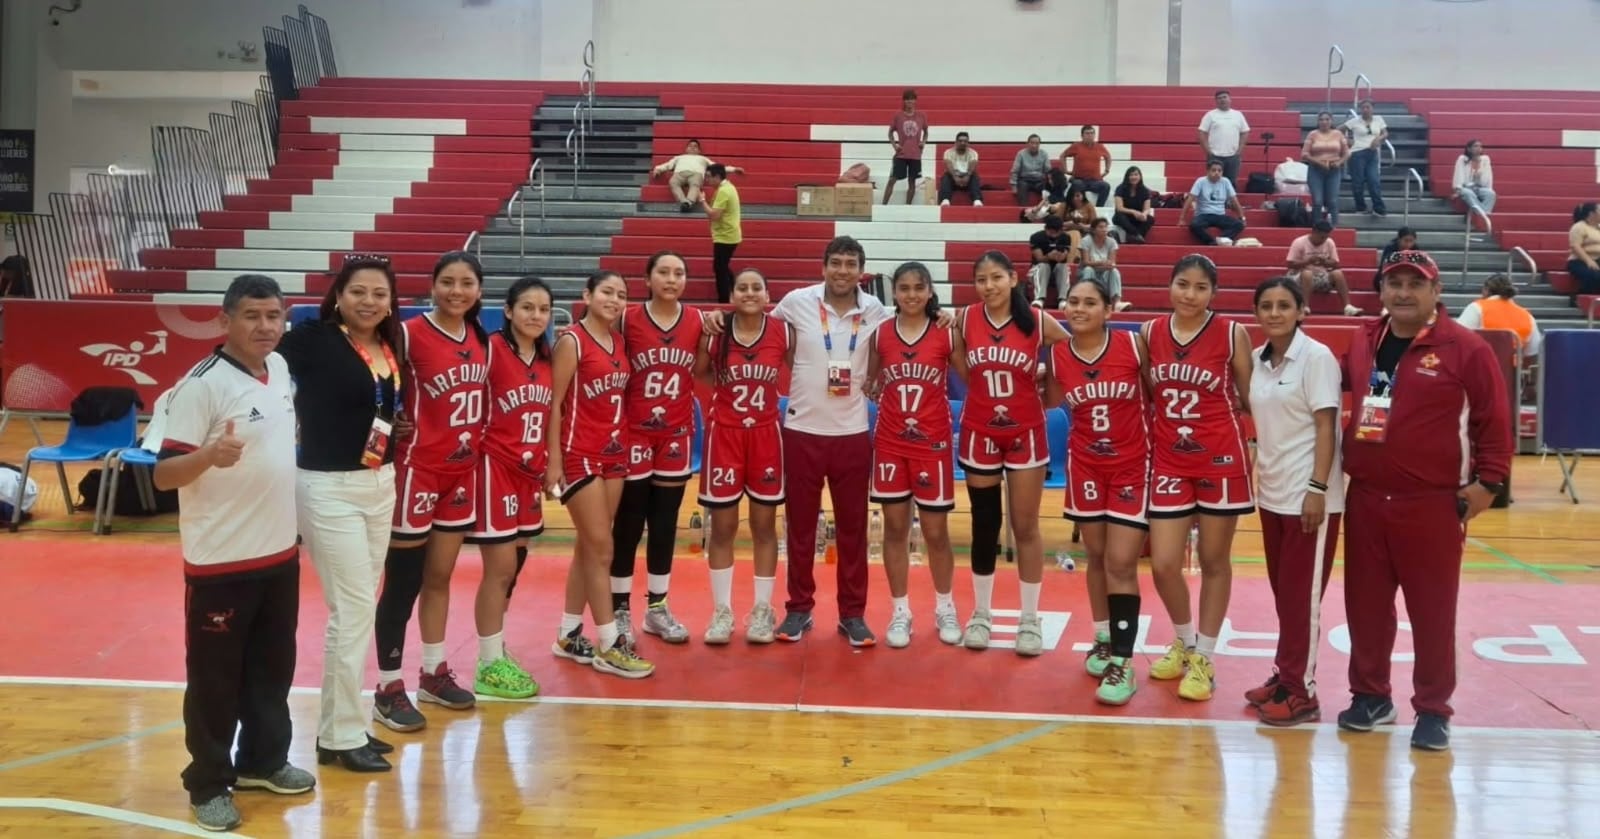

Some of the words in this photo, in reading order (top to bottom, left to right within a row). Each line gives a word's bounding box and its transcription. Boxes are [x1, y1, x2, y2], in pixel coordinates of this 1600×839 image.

[0, 149, 28, 158] UJERES
[0, 183, 28, 192] OMBRES
[103, 353, 141, 366] IPD
[966, 346, 1033, 373] REQUIPA
[423, 363, 486, 399] AREQUI
[583, 371, 630, 399] AREQUI
[644, 372, 680, 399] 64
[883, 362, 943, 386] REQUIPA
[982, 370, 1014, 398] 10
[1151, 363, 1220, 392] REQUIPA
[449, 389, 482, 427] 20
[497, 383, 552, 414] AREQUIP
[732, 385, 765, 412] 24
[897, 384, 924, 413] 17
[1065, 381, 1136, 409] REQUIPA
[1162, 388, 1201, 419] 22
[611, 394, 622, 424] 7
[1091, 404, 1110, 432] 8
[521, 411, 543, 443] 18
[630, 445, 652, 465] 64
[712, 467, 736, 486] 24
[878, 463, 896, 482] 17
[1155, 475, 1181, 494] 22
[1083, 481, 1098, 500] 8
[502, 494, 519, 517] 18
